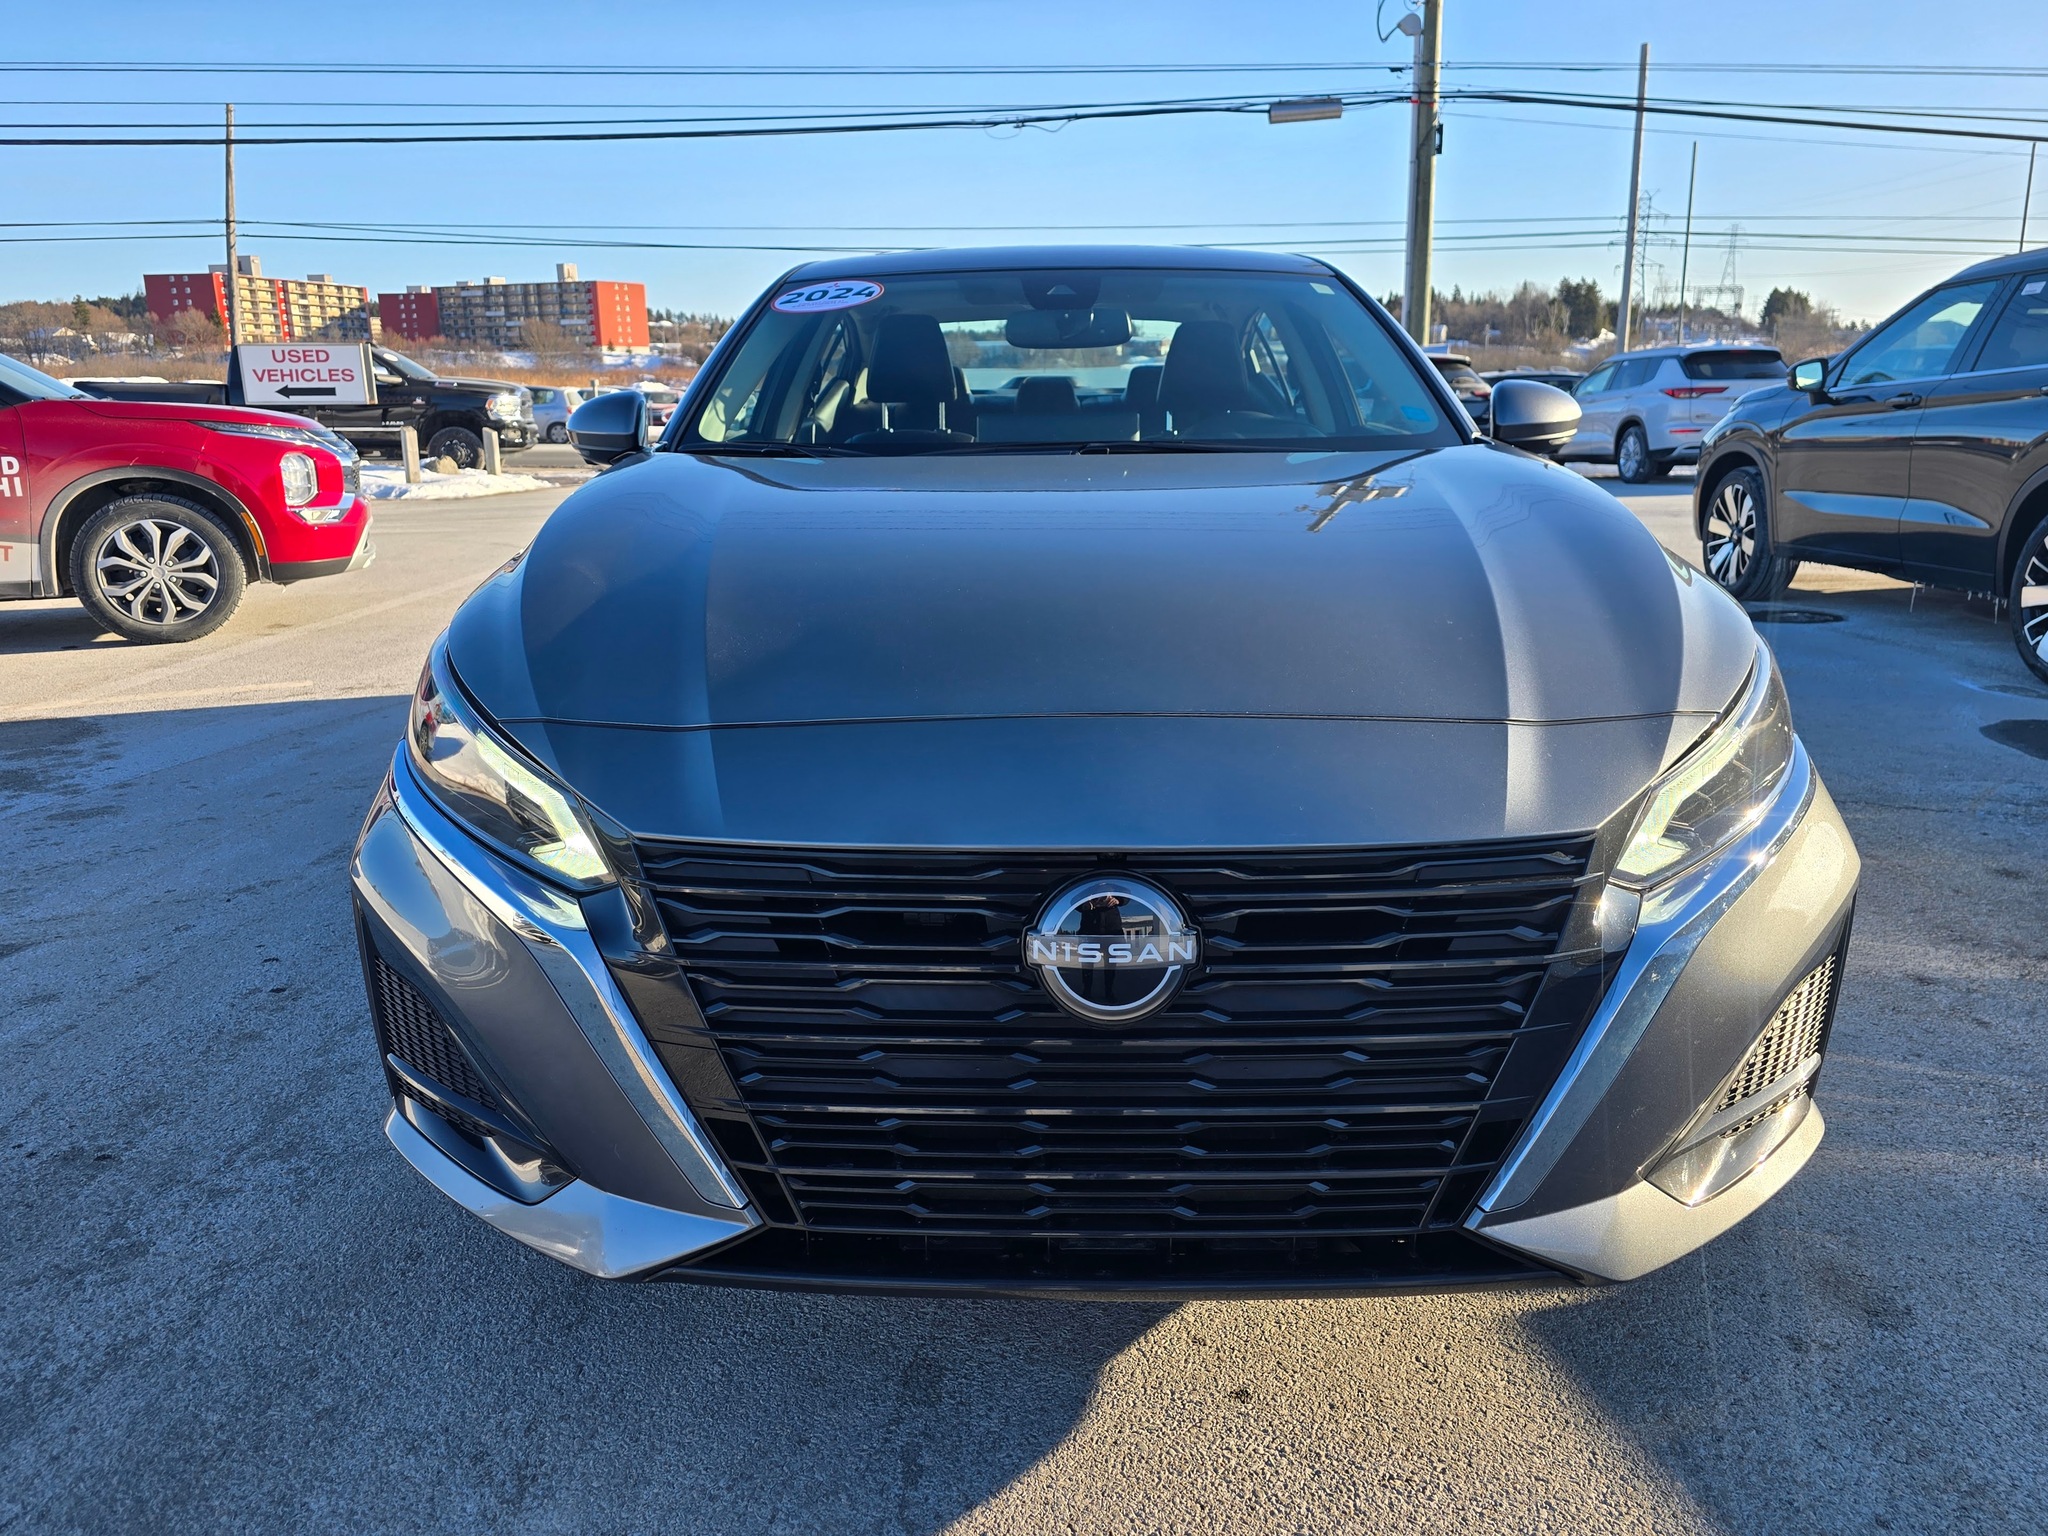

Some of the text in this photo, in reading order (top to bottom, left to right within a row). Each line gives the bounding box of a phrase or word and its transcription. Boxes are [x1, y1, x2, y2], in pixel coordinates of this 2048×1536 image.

[779, 285, 875, 305] 2024
[271, 349, 330, 363] USED
[252, 368, 355, 383] VEHICLES
[1032, 939, 1193, 963] NISSAN
